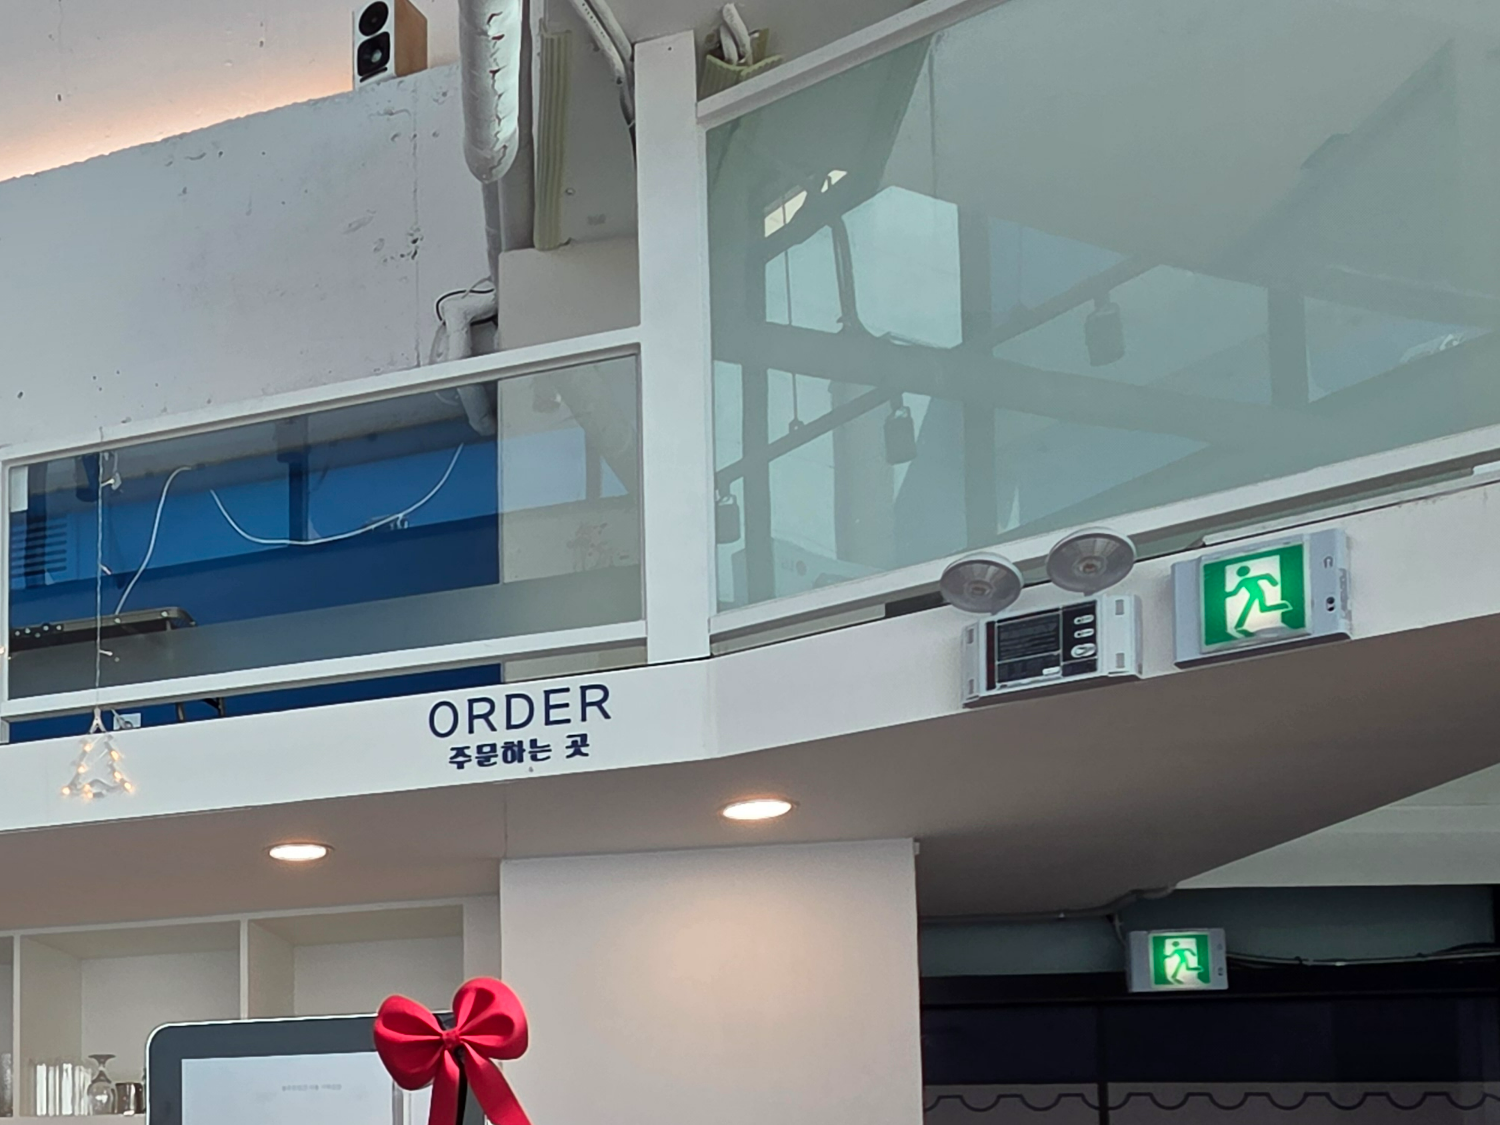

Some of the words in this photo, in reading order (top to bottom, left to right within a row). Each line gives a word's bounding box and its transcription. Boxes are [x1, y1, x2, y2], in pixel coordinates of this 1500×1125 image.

[428, 683, 612, 738] ORDER
[448, 738, 552, 769] 주문하는
[564, 733, 591, 759] 곳
